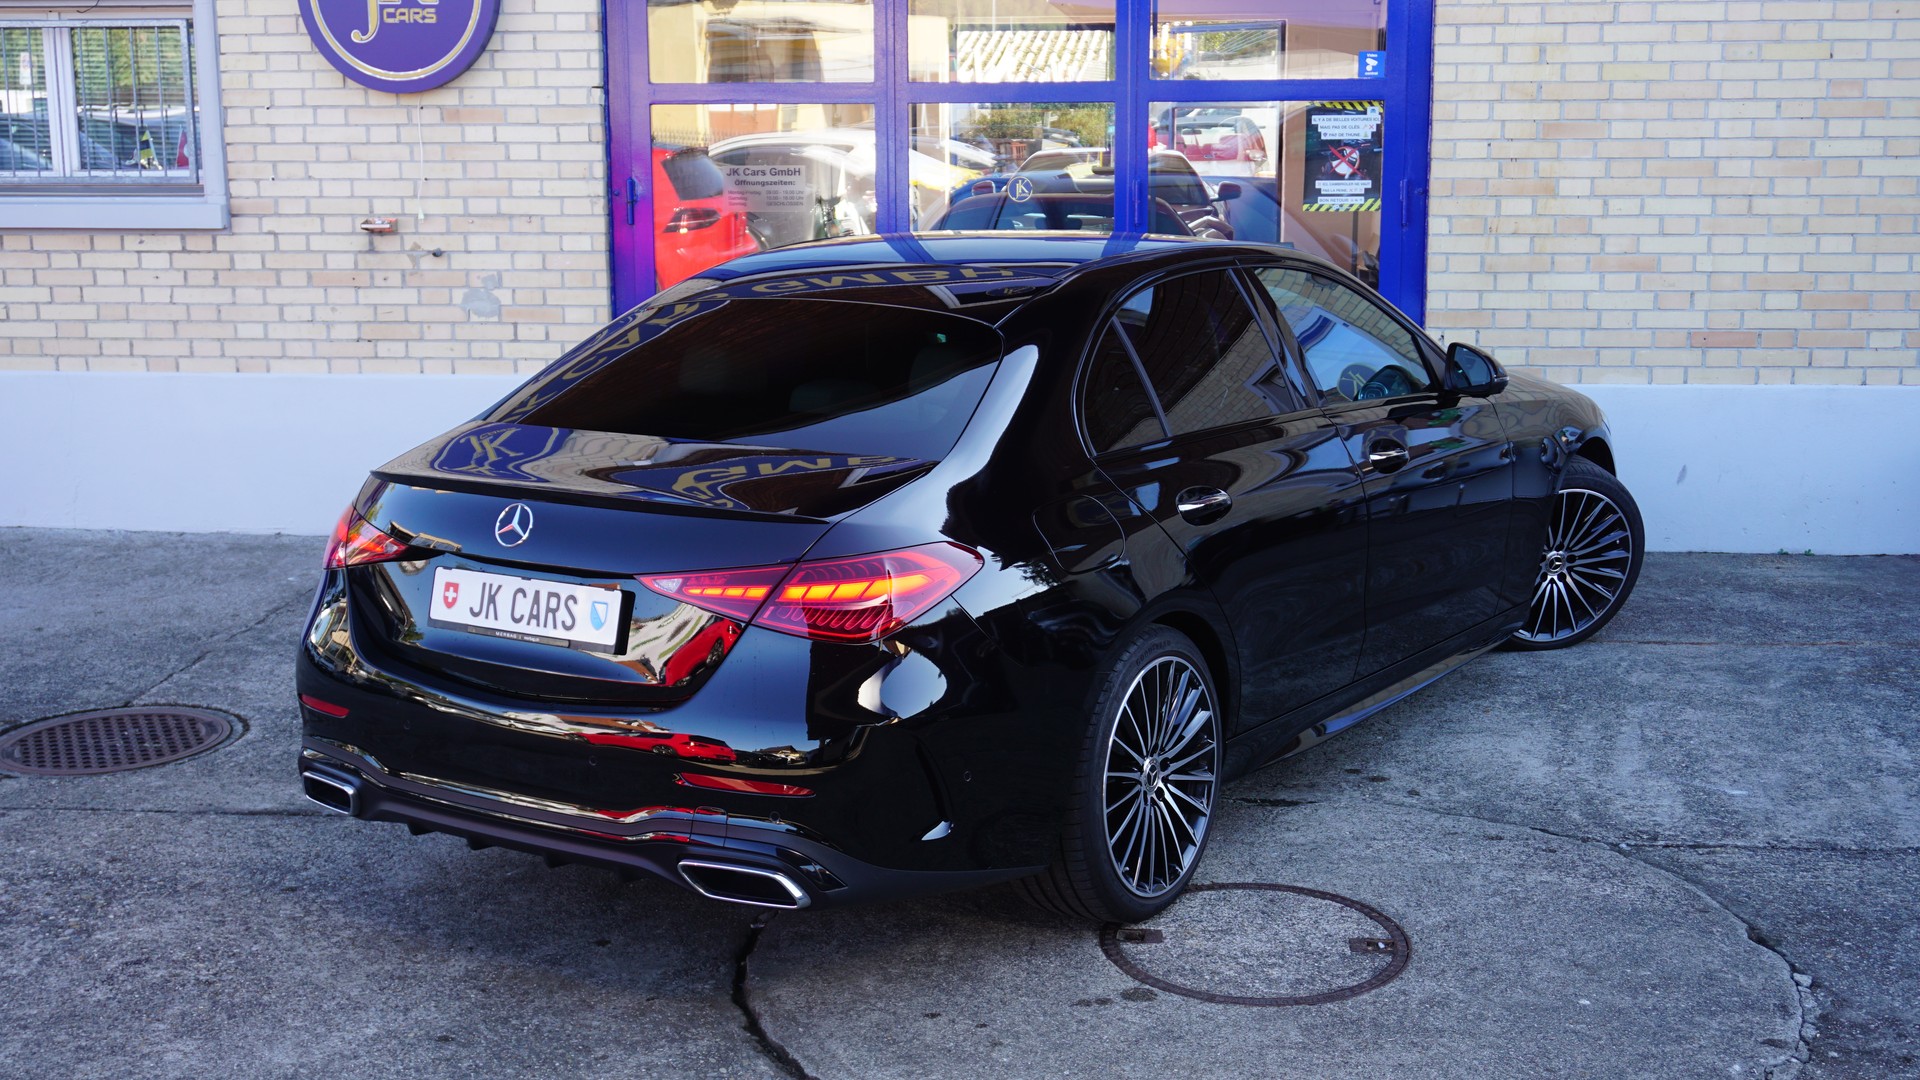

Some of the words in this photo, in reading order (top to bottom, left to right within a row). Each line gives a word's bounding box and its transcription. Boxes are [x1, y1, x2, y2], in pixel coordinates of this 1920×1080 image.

[383, 8, 437, 23] CARS
[726, 168, 740, 176] JK
[743, 167, 766, 176] Cars
[769, 167, 801, 176] GmbH
[734, 179, 796, 187] Öffnungszeiten:
[469, 582, 503, 621] JK
[510, 587, 578, 632] CARS
[495, 631, 517, 639] MERBAG
